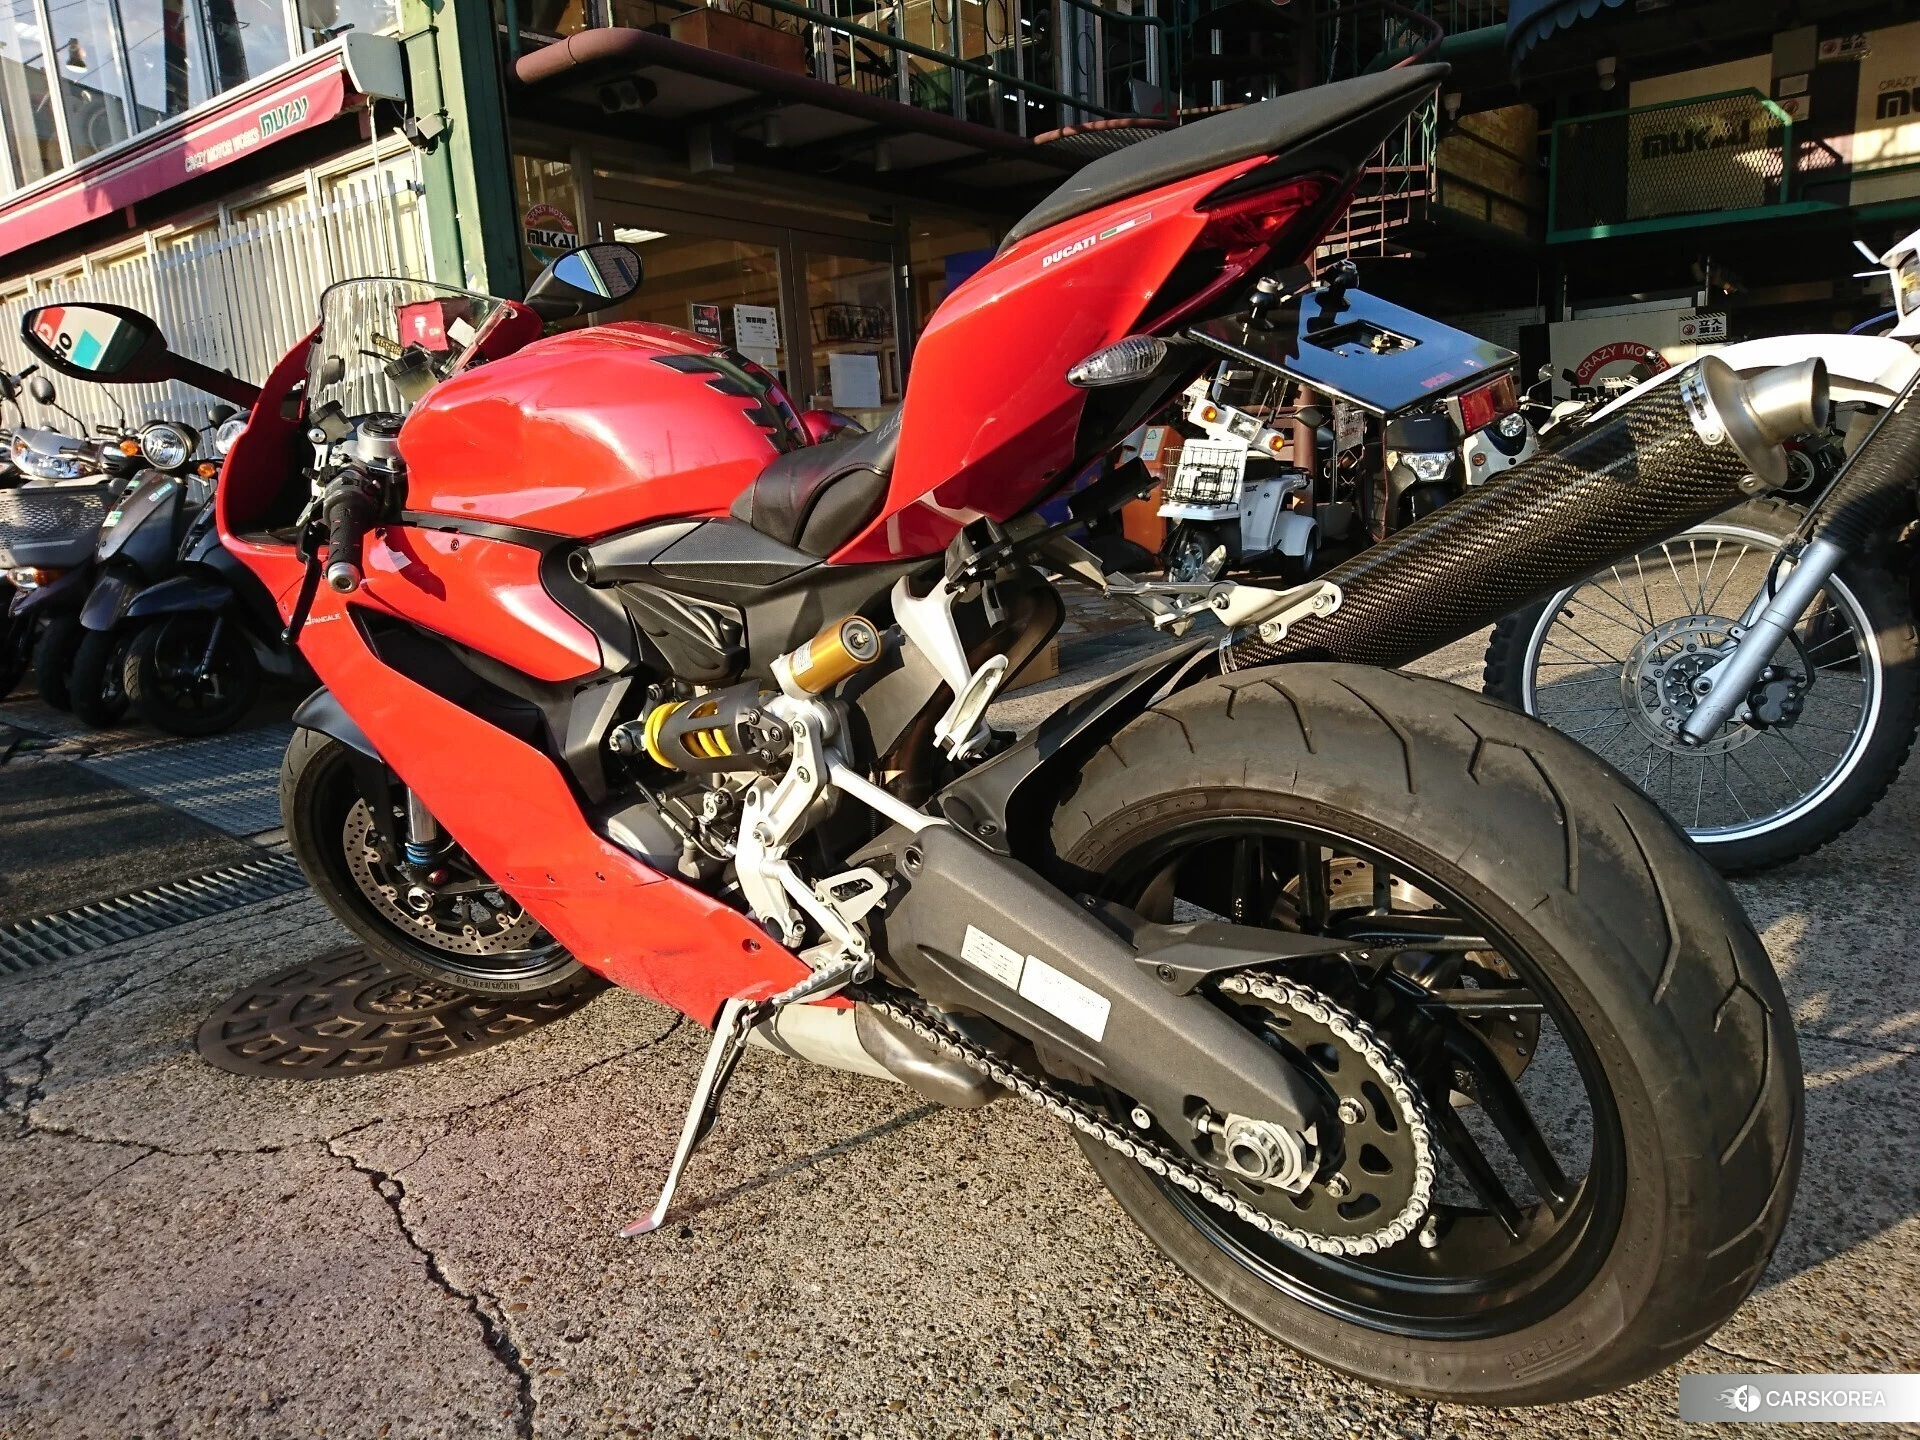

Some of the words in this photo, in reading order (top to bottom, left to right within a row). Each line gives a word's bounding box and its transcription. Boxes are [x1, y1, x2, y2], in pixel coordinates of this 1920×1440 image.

[1879, 75, 1918, 90] CRAZY
[528, 205, 547, 221] CRAZY
[548, 206, 573, 227] MOTOR
[526, 229, 576, 249] MUKAI
[1042, 235, 1096, 268] DUCATI
[1699, 318, 1722, 327] 立入
[1578, 346, 1616, 378] CRAZY
[1622, 344, 1667, 374] MOOR
